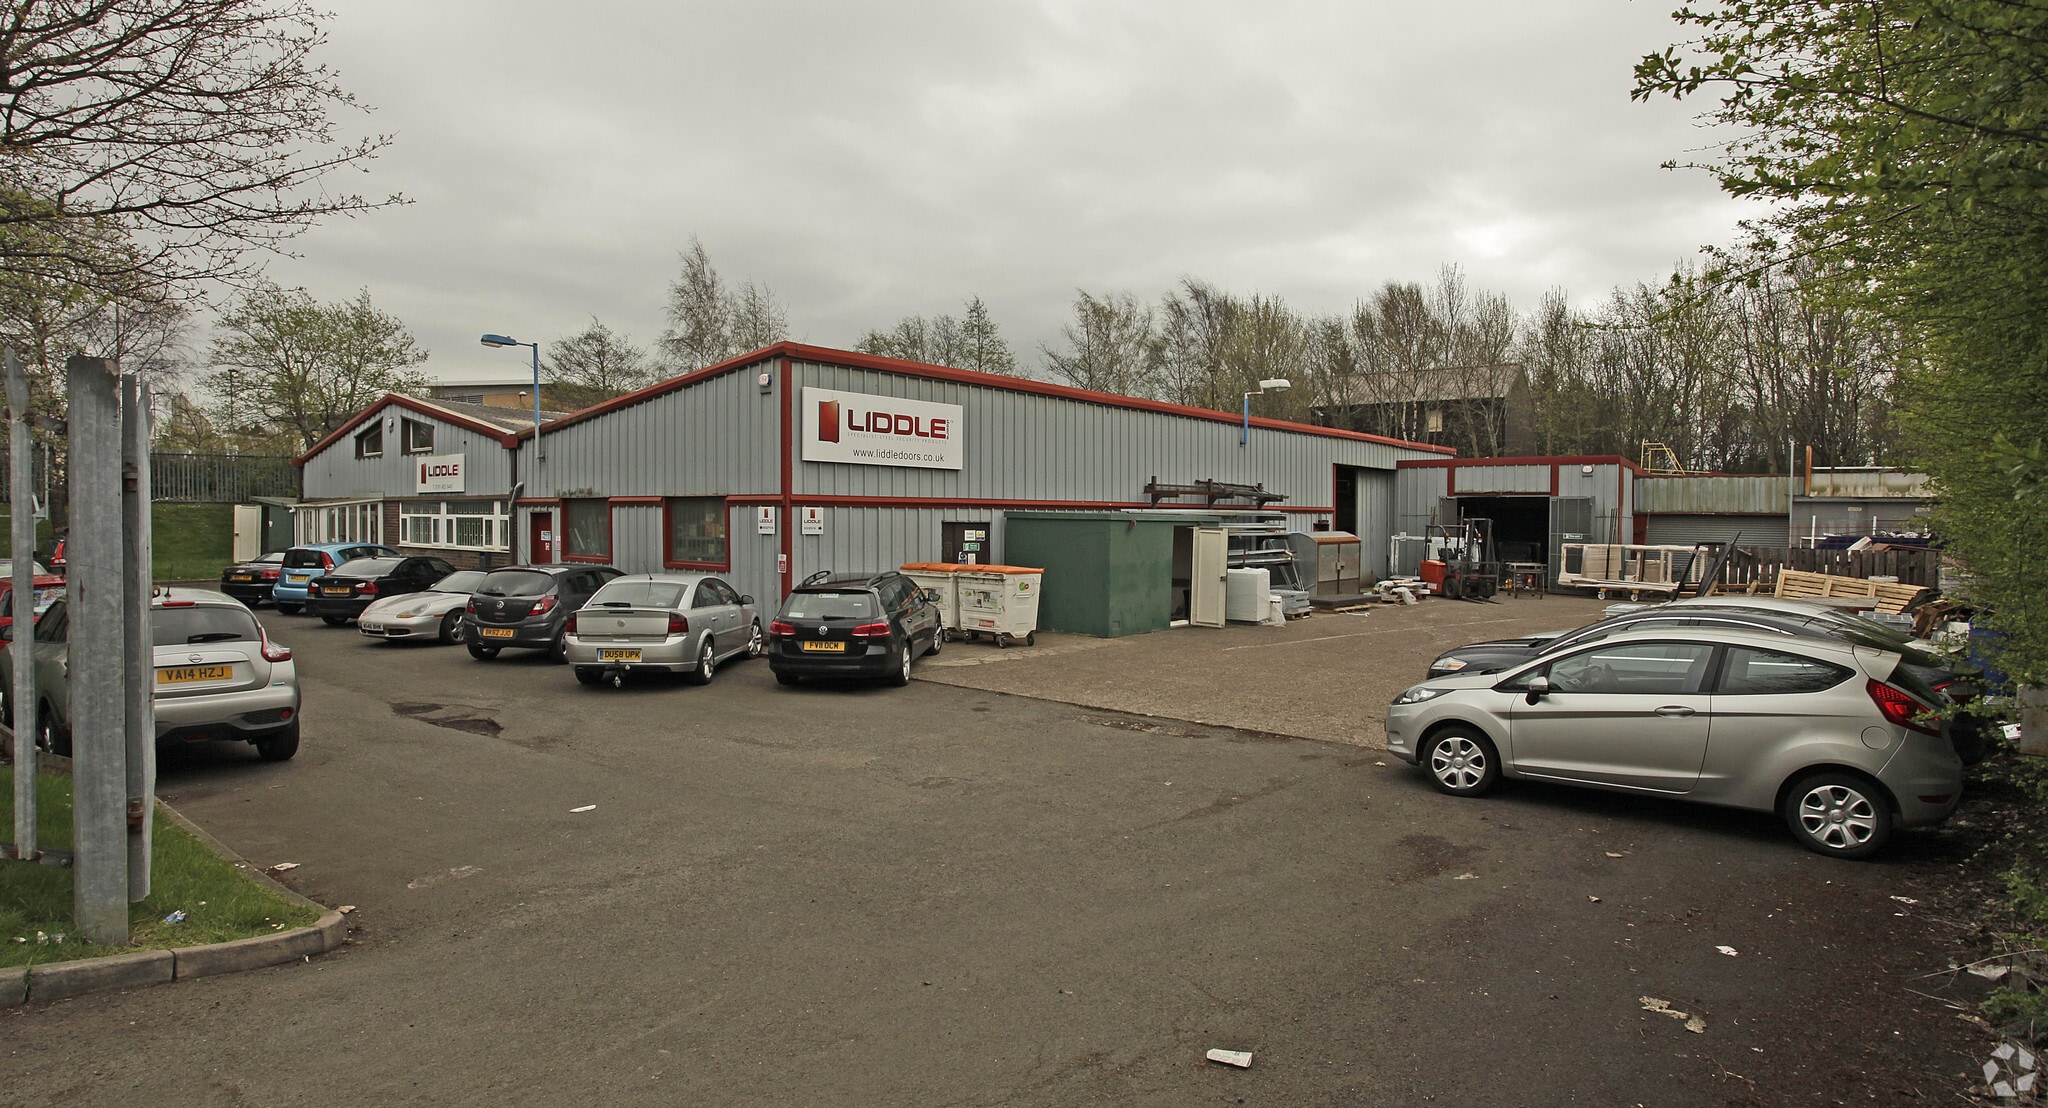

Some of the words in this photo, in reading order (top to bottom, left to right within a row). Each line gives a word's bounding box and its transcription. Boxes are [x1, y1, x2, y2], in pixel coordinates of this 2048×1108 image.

[847, 409, 947, 439] LIDDLE
[852, 448, 945, 462] www.liddledoors.co.uk
[428, 464, 459, 477] LIDDLE
[604, 650, 624, 658] DU58
[625, 650, 641, 658] UPK
[166, 668, 195, 681] VA14
[199, 666, 225, 678] HZJ
